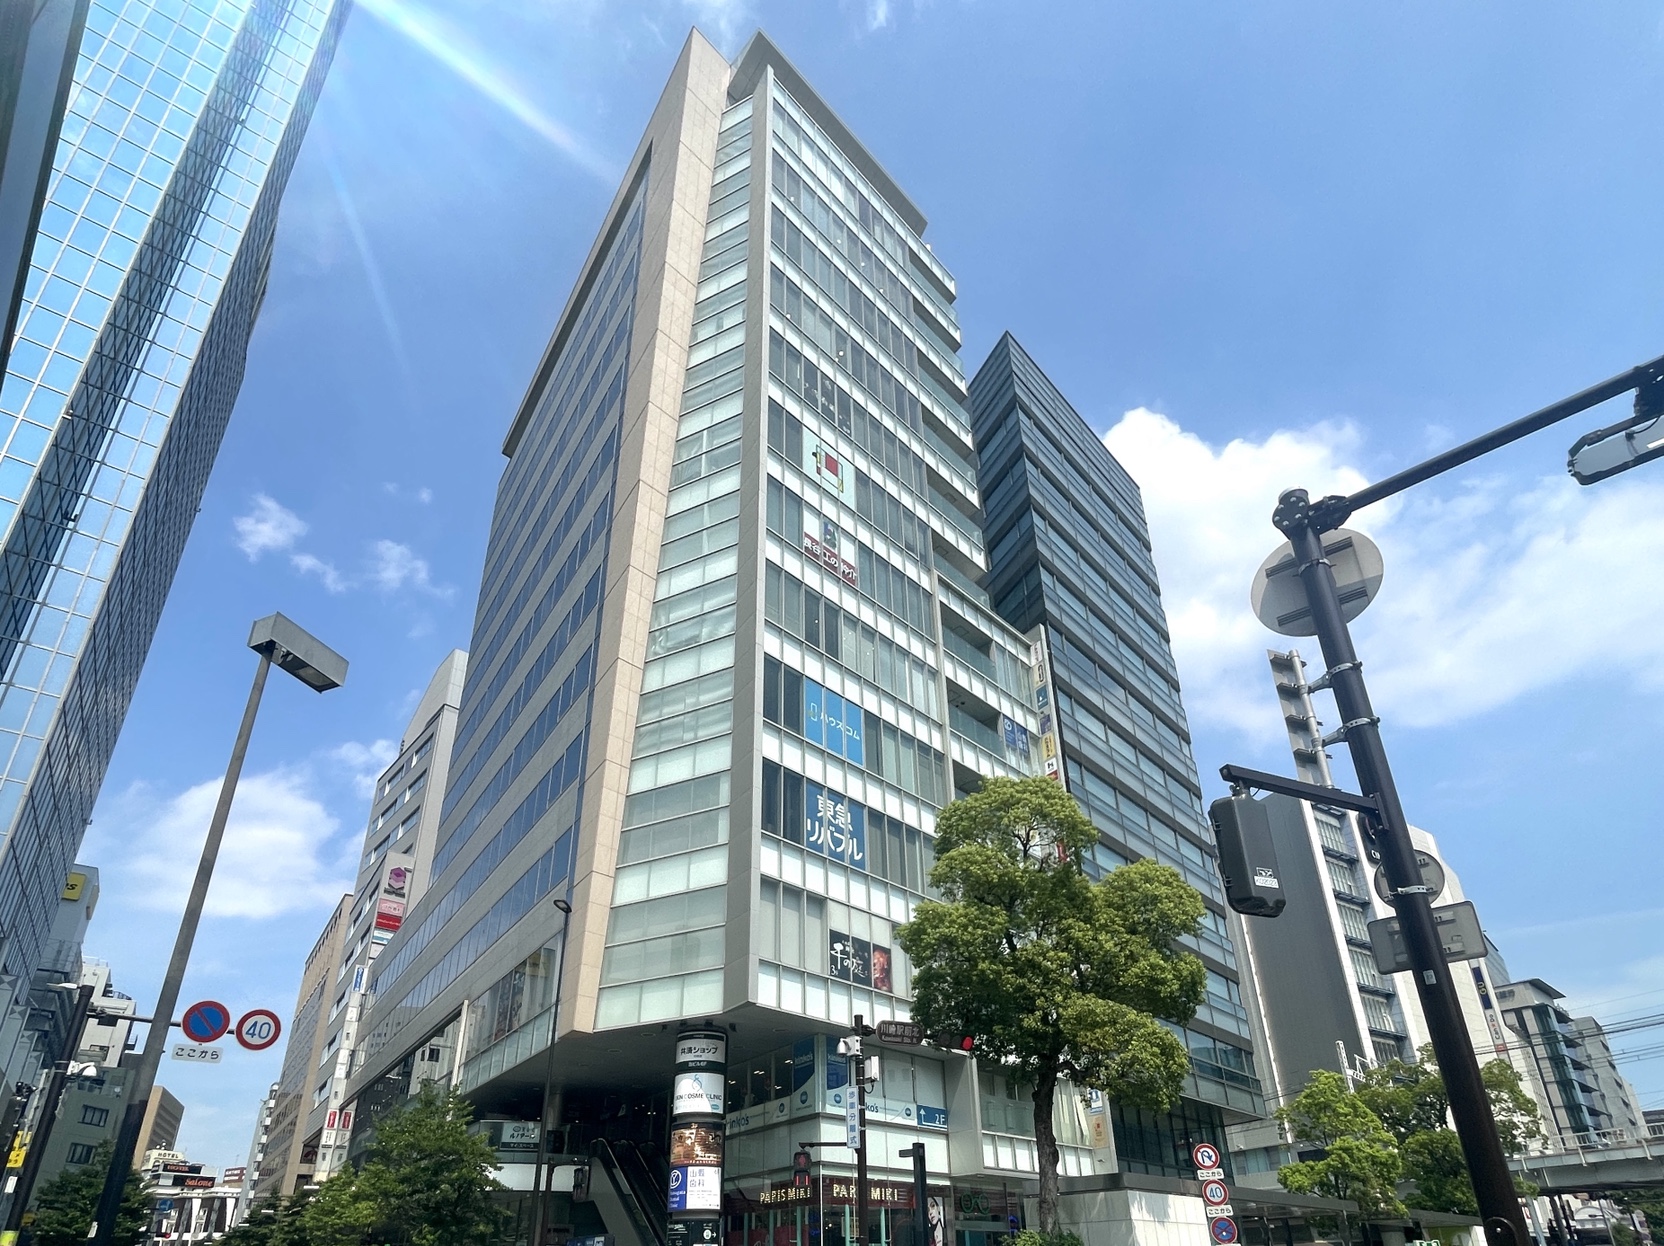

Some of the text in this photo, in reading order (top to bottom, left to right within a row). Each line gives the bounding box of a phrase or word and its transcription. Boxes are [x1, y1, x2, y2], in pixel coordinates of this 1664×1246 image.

[820, 712, 861, 741] ハウスコム
[816, 794, 854, 832] 東急
[806, 818, 864, 861] リバブル
[1477, 981, 1487, 995] GU
[245, 1020, 272, 1040] 40
[175, 1047, 220, 1060] ここから
[934, 1113, 946, 1125] 2F
[157, 1151, 179, 1159] HOTEL
[1199, 1170, 1222, 1178] ここから
[832, 1184, 898, 1201] PAR MIKI
[1208, 1186, 1223, 1199] 40
[1208, 1207, 1232, 1215] ここから
